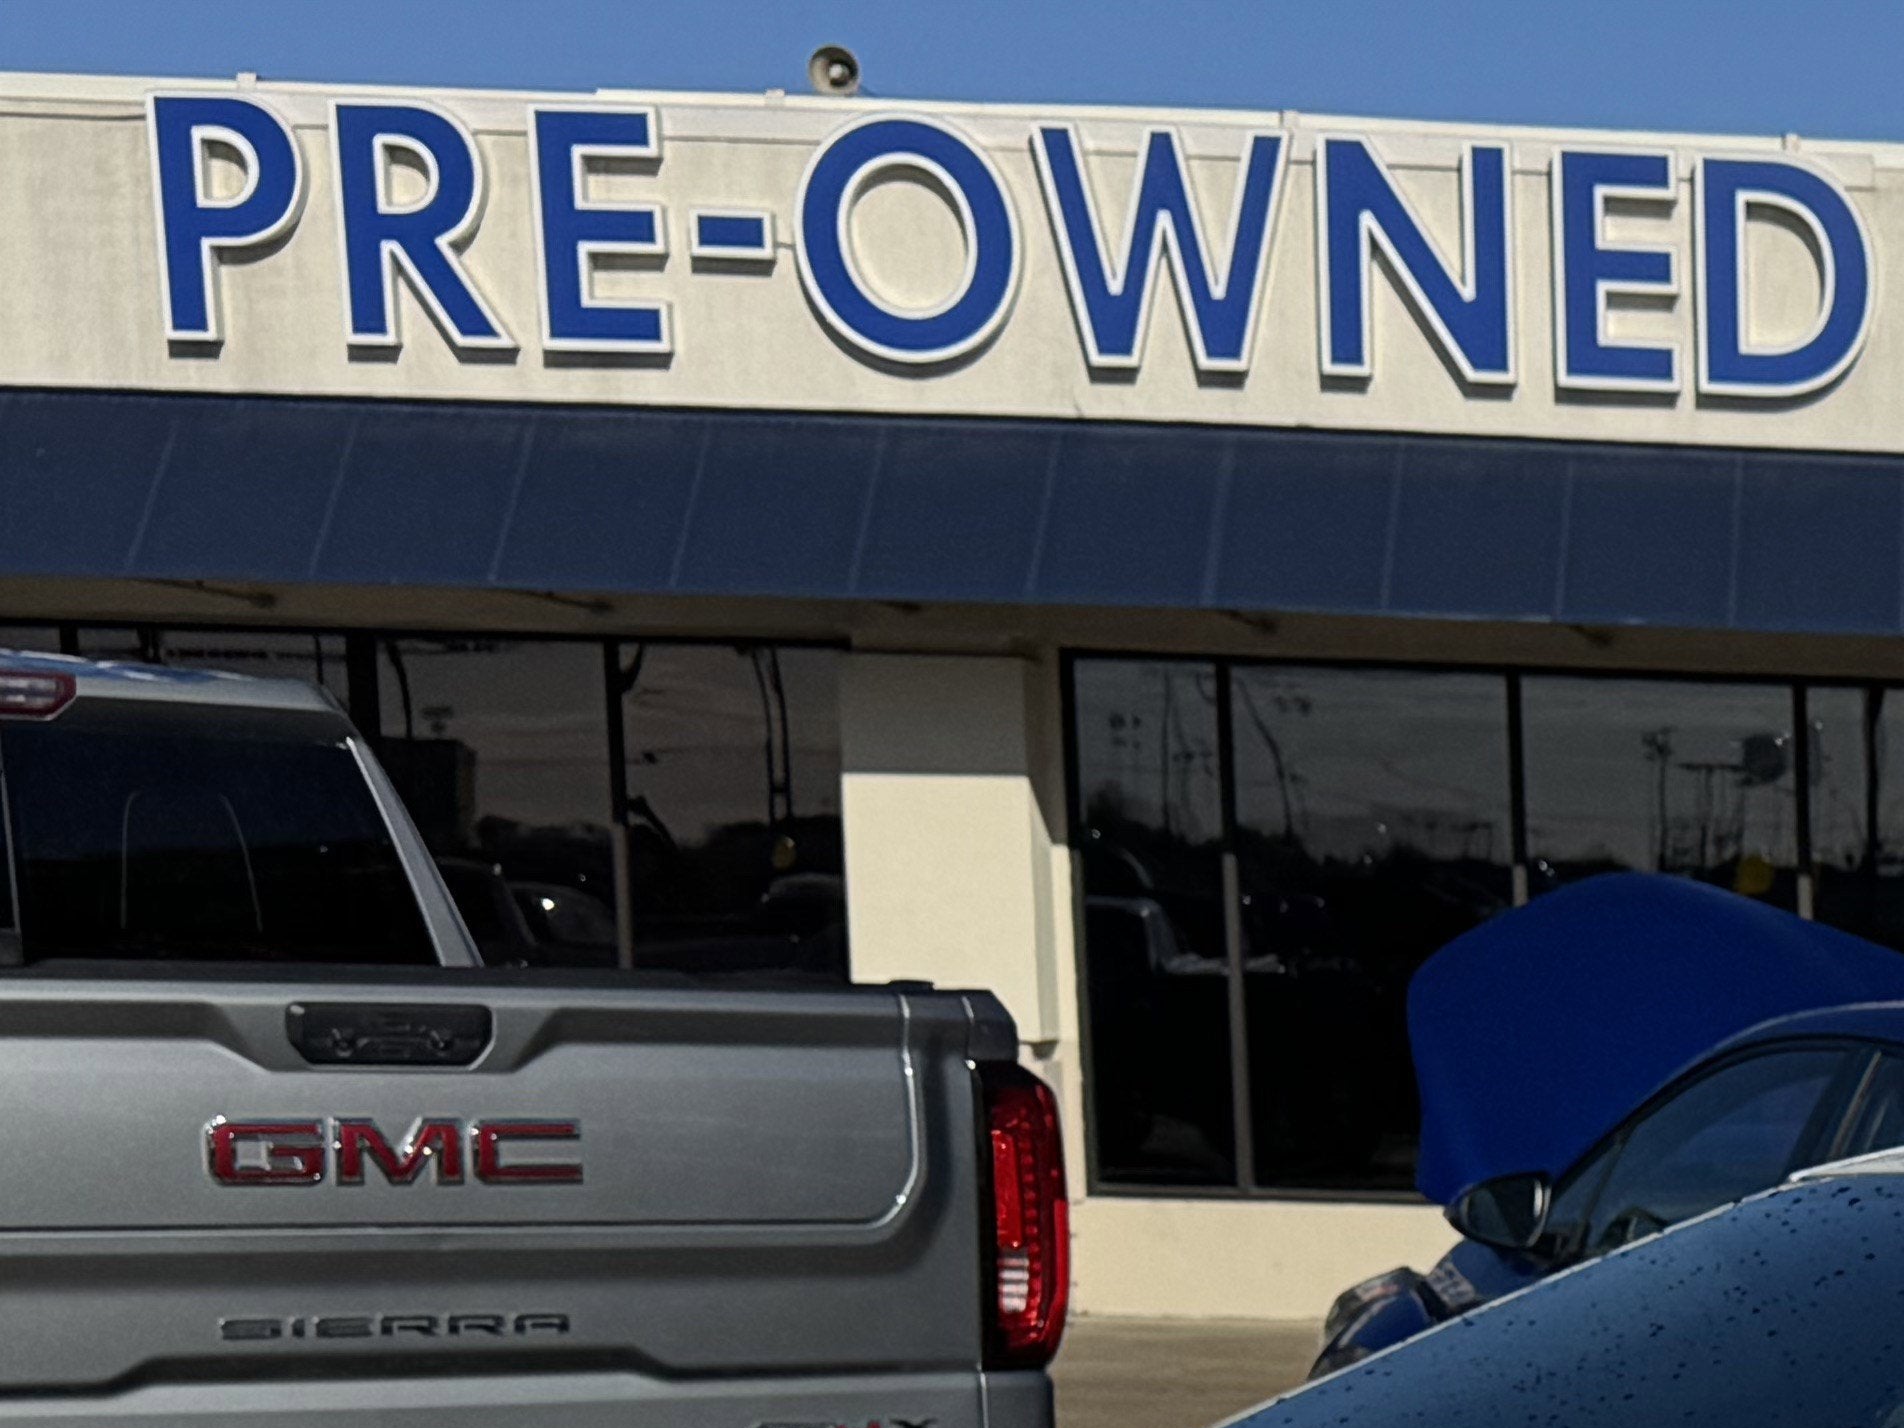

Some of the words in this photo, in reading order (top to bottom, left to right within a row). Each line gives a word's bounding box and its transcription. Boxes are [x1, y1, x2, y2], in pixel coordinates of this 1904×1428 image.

[146, 90, 1874, 400] PRE-OWNED
[203, 1115, 584, 1186] GMC
[217, 1313, 571, 1341] SIERRA
